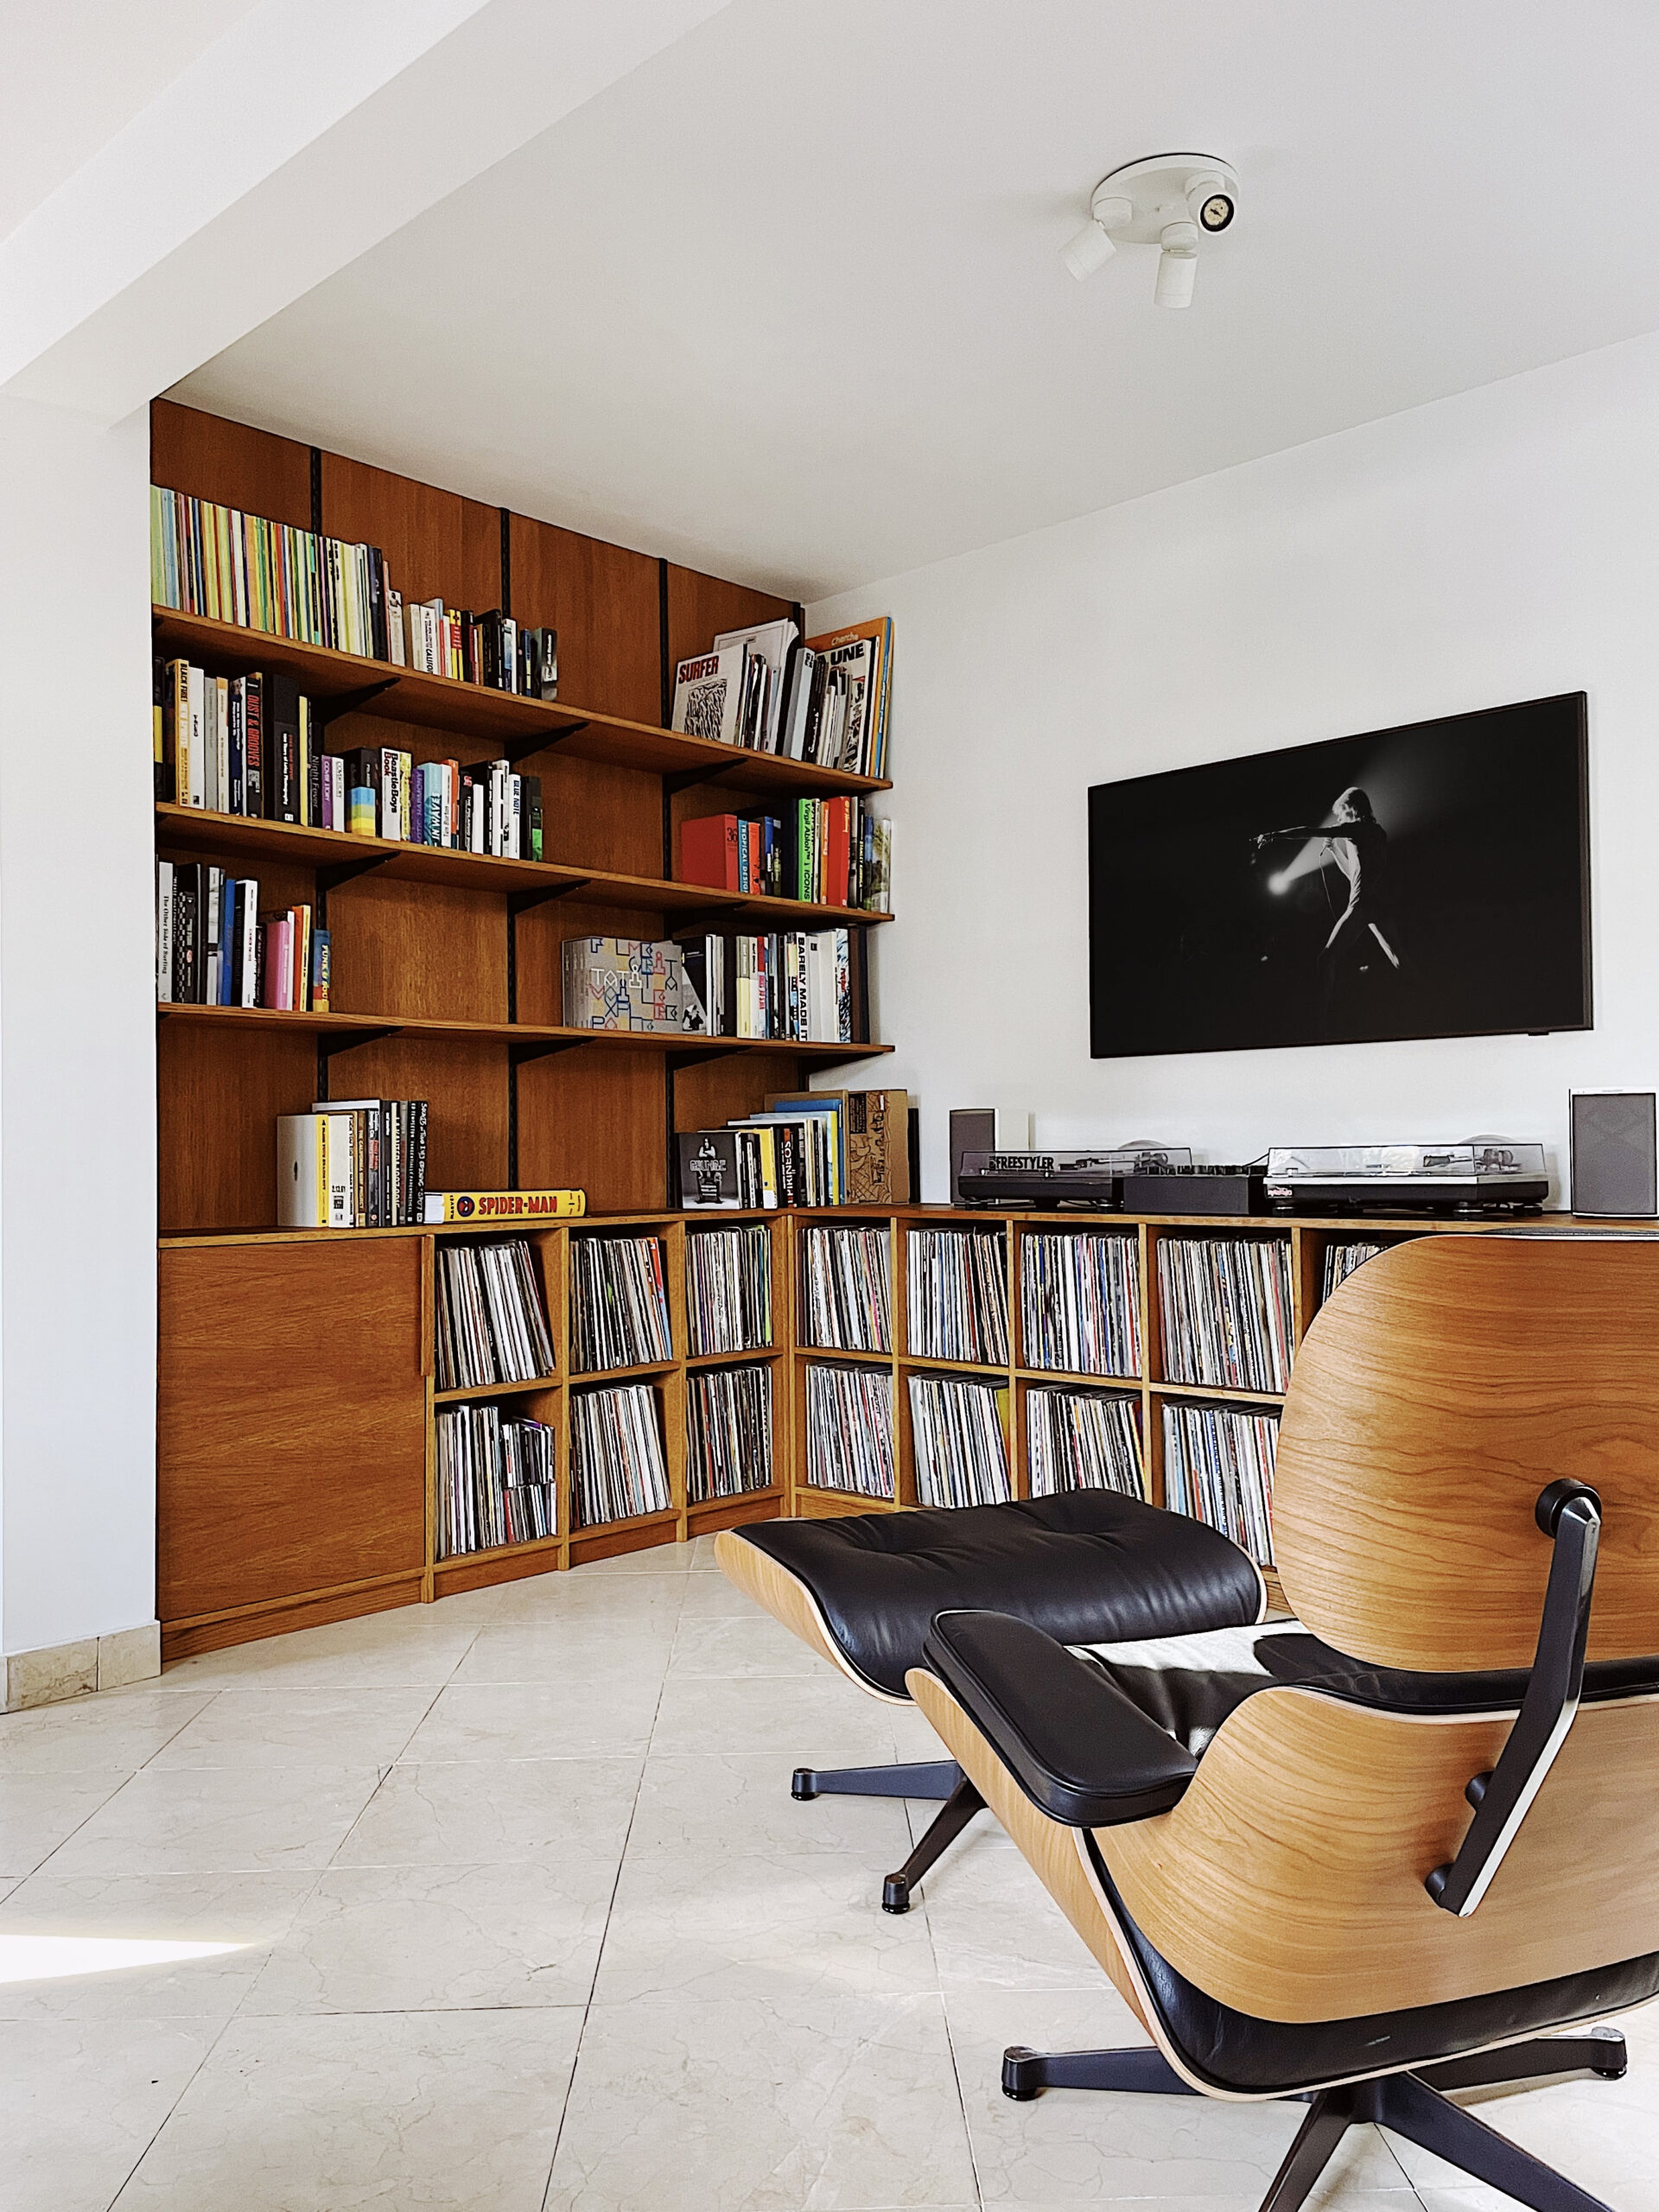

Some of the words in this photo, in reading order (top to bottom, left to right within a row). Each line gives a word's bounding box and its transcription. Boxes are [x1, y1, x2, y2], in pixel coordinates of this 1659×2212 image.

[830, 642, 864, 665] UNE
[678, 655, 719, 683] SURFER
[247, 695, 260, 717] DUST
[247, 718, 260, 727] &
[247, 728, 260, 766] GROOVES
[311, 755, 320, 780] Night
[431, 791, 440, 829] WAVES
[431, 829, 440, 842] IN
[800, 1029, 807, 1041] IT
[690, 1160, 727, 1172] GRUNGE
[995, 1156, 1054, 1169] FREESTYLER
[478, 1196, 557, 1215] SPIDER-MAN
